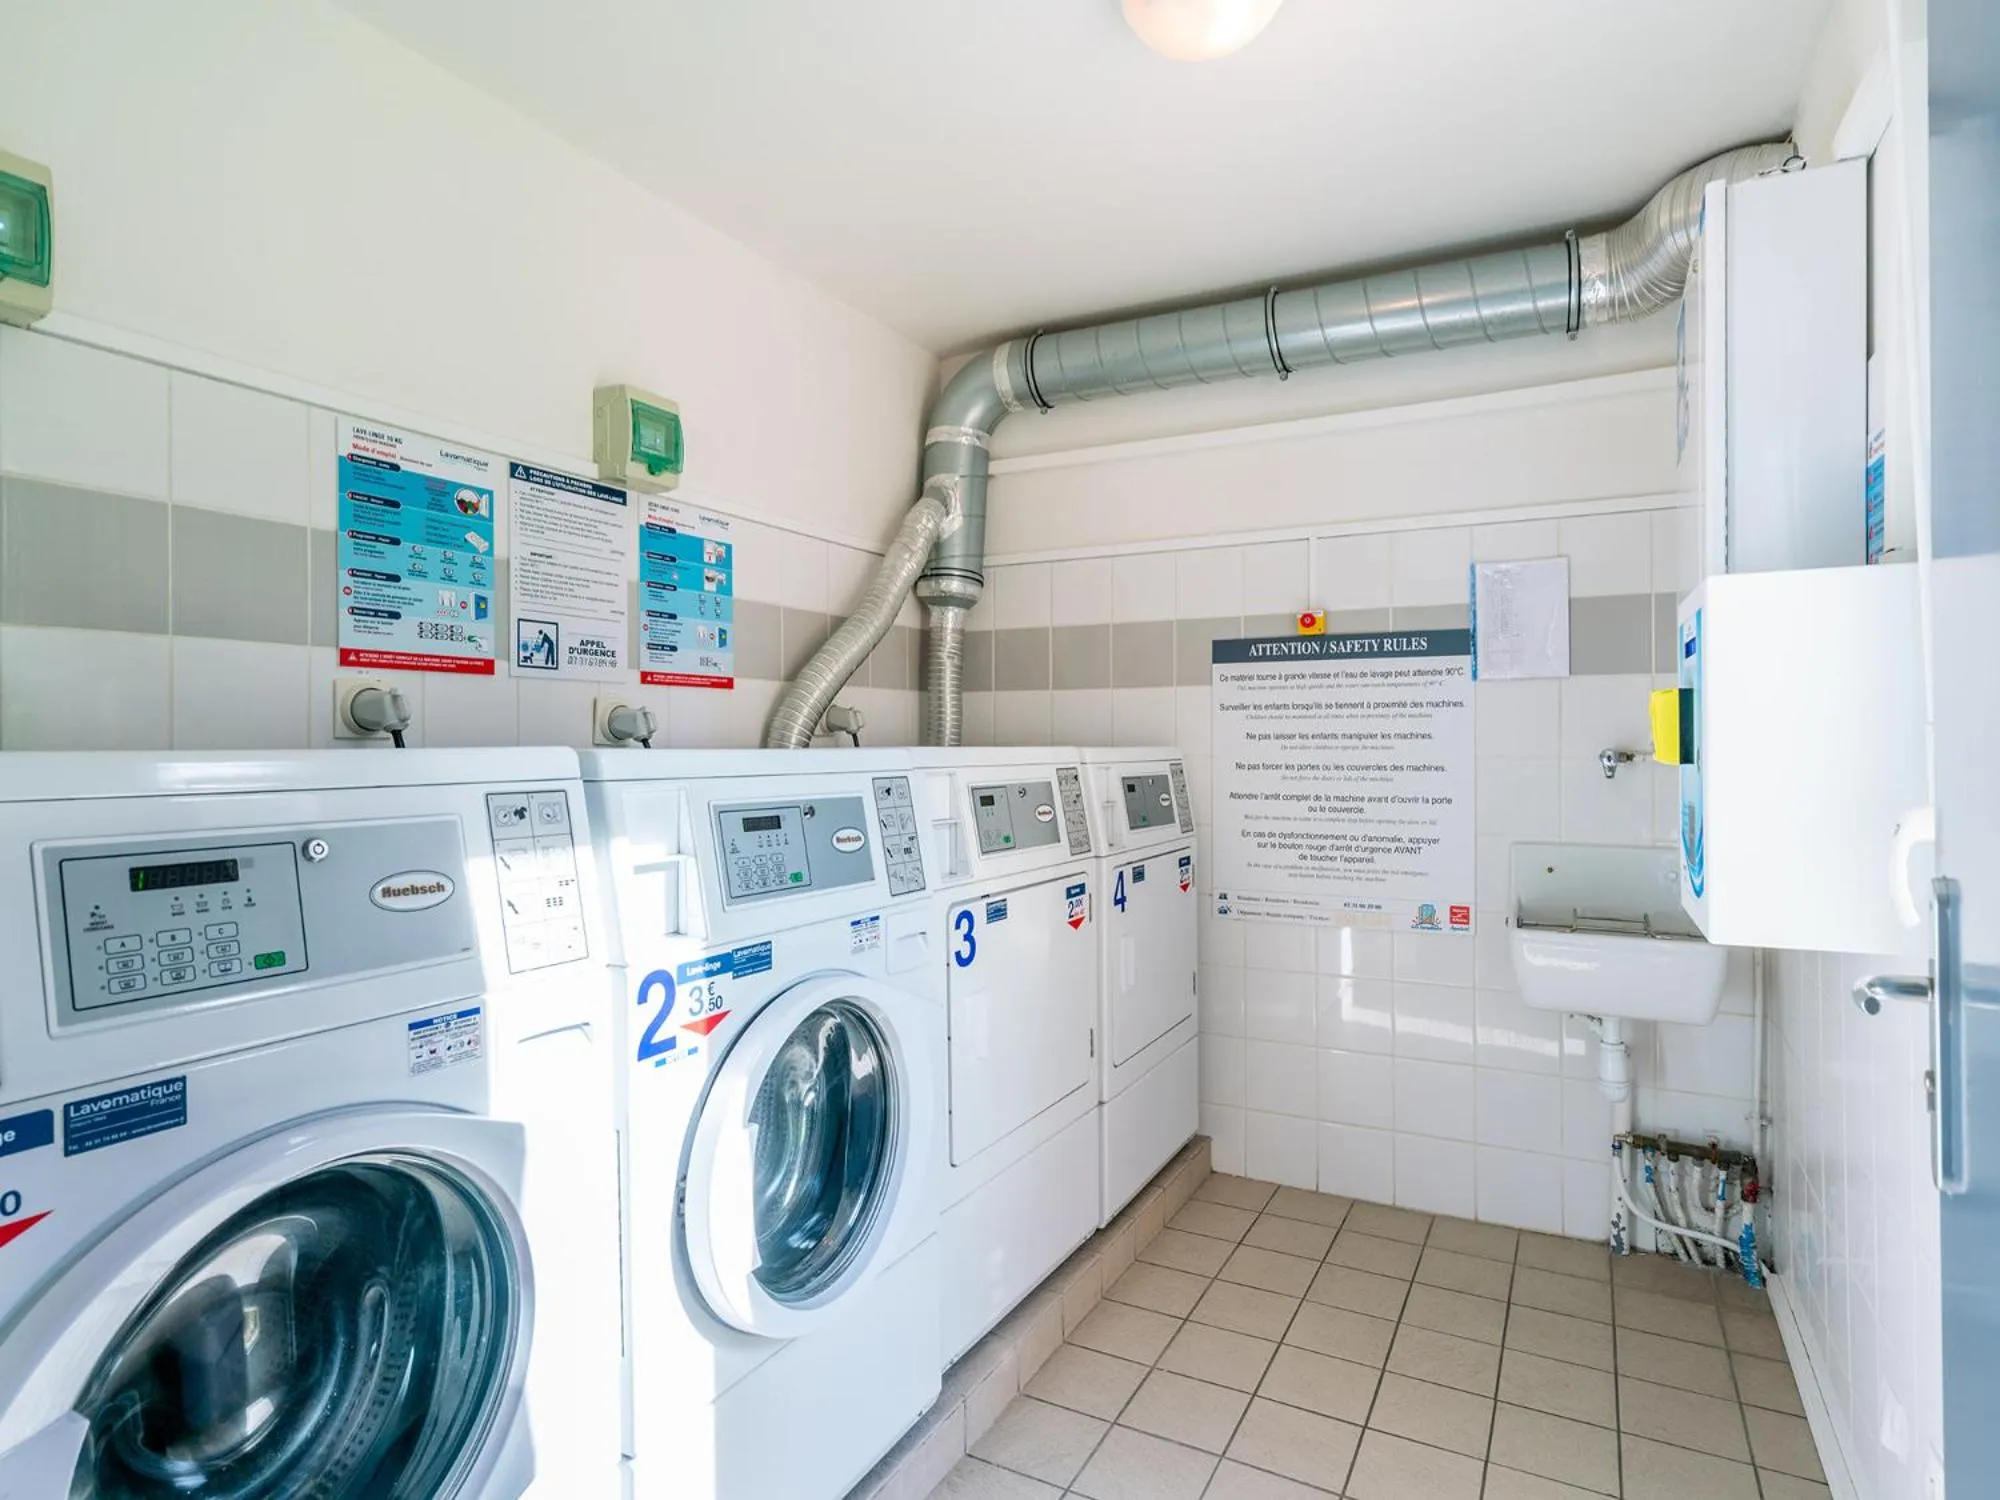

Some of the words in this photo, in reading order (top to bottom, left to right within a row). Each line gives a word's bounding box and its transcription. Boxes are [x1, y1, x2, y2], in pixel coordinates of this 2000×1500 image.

[580, 640, 606, 648] APPEL
[1249, 641, 1320, 656] ATTENTION
[1322, 640, 1328, 654] /
[1330, 638, 1380, 654] SAFETY
[1383, 637, 1428, 652] RULES
[568, 646, 616, 658] D'URGENCE
[1220, 702, 1250, 711] Surveiller
[1264, 702, 1290, 710] enfants
[1409, 699, 1424, 708] des
[1246, 732, 1256, 740] Ne
[1258, 733, 1272, 741] pas
[1311, 732, 1338, 740] enfants
[1235, 762, 1246, 770] Ne
[1248, 763, 1260, 771] pas
[1297, 763, 1320, 772] portes
[1334, 763, 1344, 771] les
[1390, 764, 1404, 772] des
[1332, 794, 1366, 802] machine
[1241, 829, 1252, 838] En
[1305, 844, 1326, 852] rouge
[1394, 846, 1422, 854] AVANT
[382, 882, 446, 898] Huebsch
[1114, 870, 1127, 912] 4
[954, 910, 976, 968] 3
[686, 961, 721, 976] Lave-linge
[637, 969, 676, 1062] 2
[70, 1081, 184, 1117] Lavomatique
[150, 1094, 182, 1108] France
